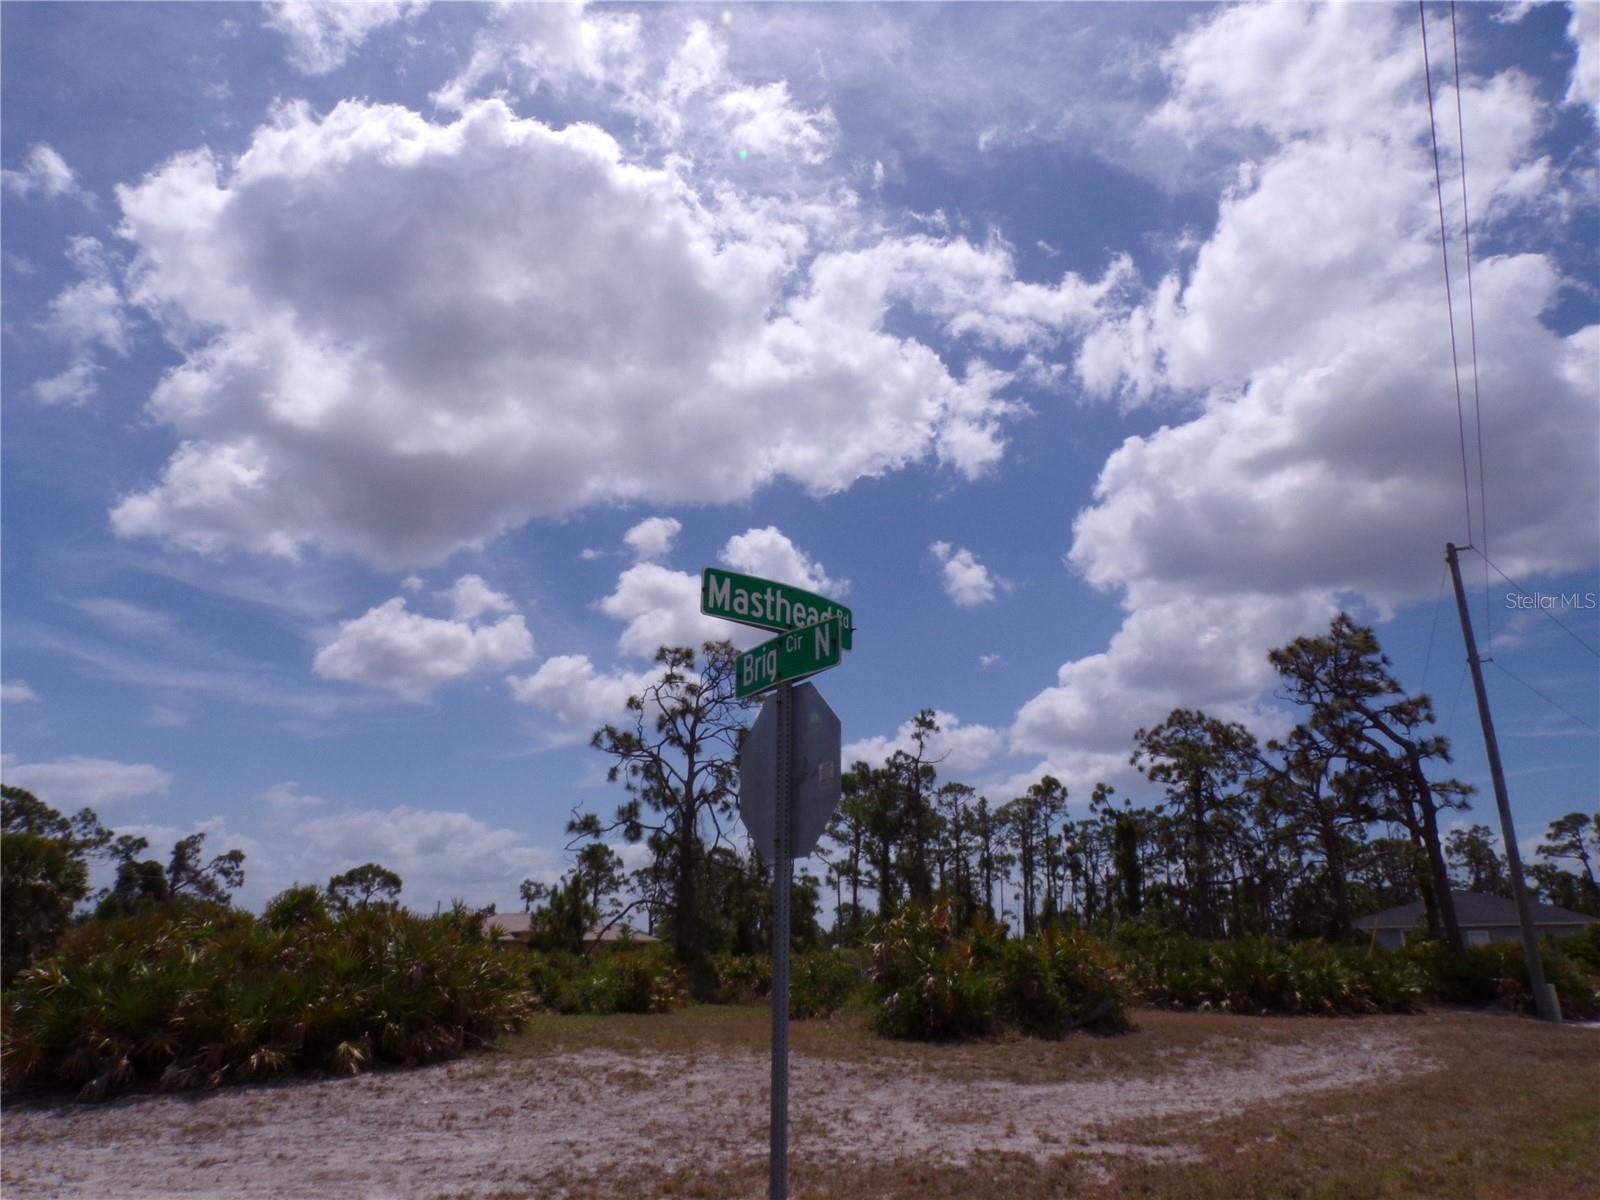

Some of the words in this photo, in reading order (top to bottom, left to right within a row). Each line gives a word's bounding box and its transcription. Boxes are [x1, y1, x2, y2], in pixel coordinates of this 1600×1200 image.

[742, 647, 778, 687] Brig
[786, 634, 804, 653] Cir
[815, 623, 830, 660] N
